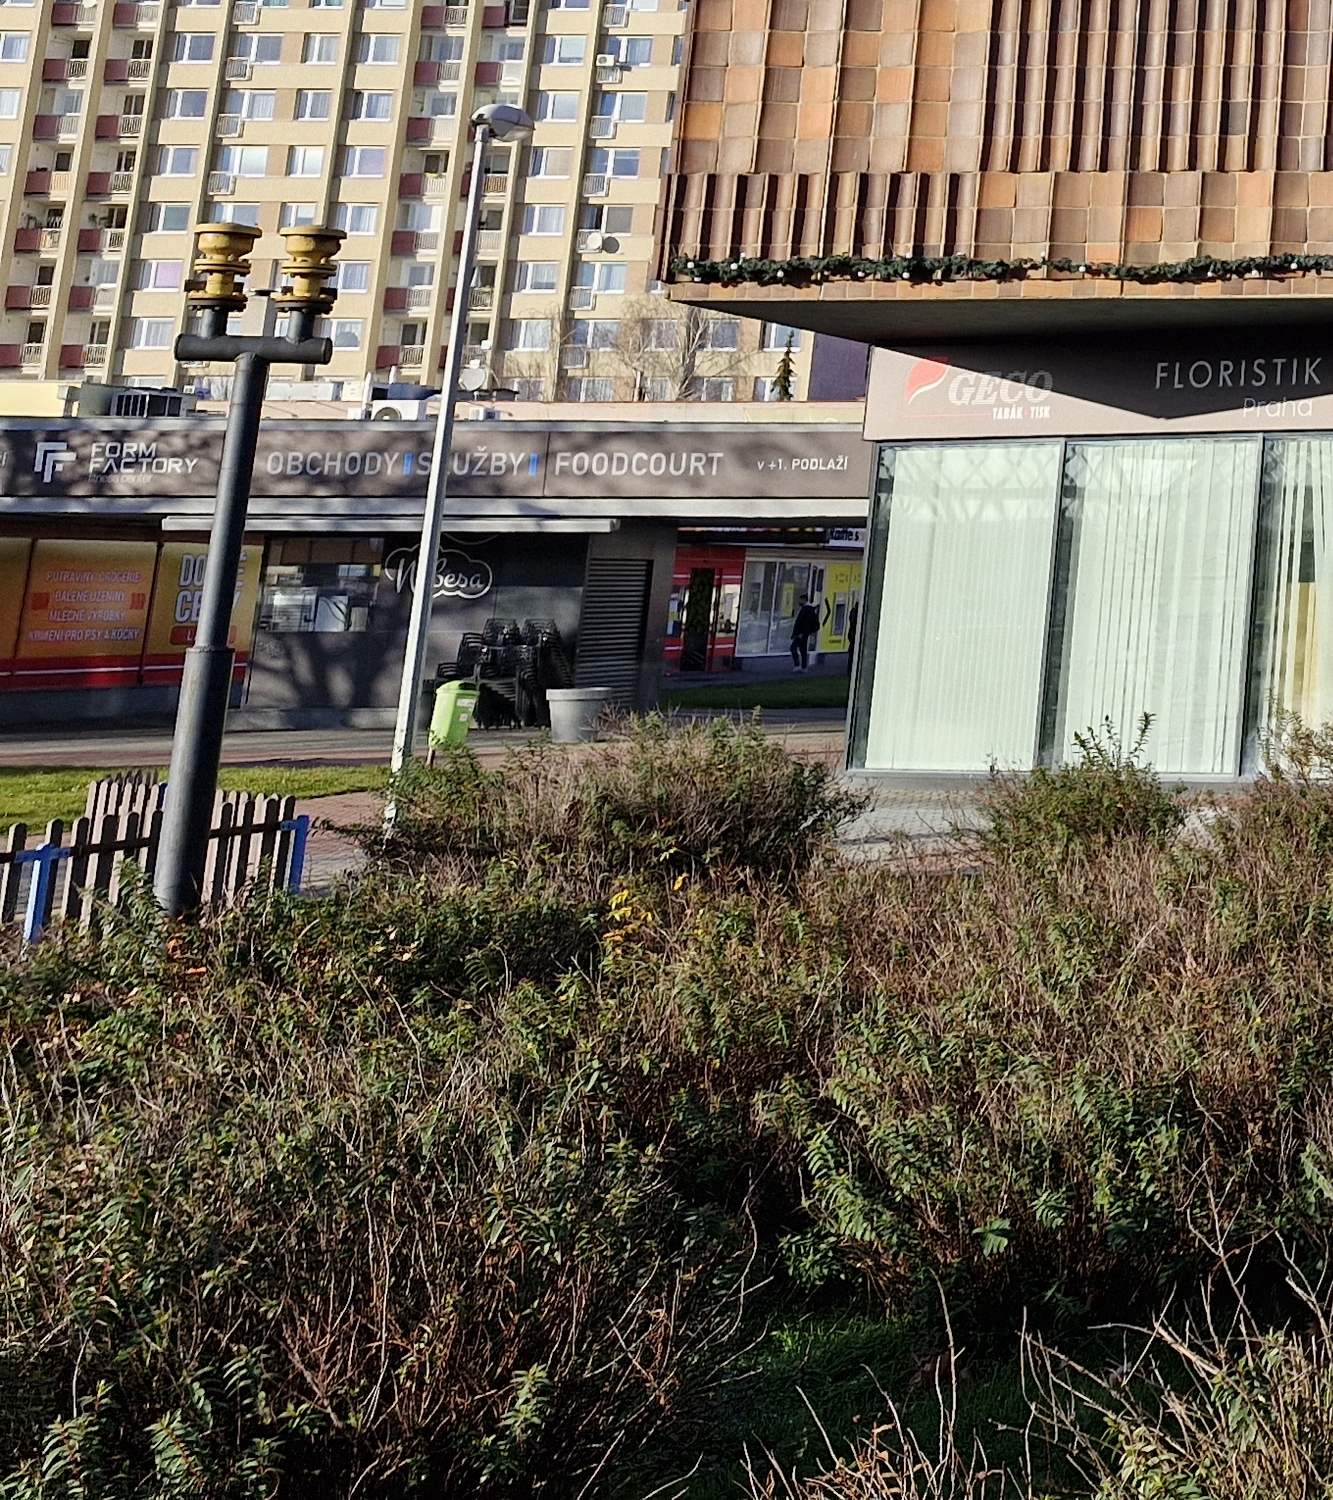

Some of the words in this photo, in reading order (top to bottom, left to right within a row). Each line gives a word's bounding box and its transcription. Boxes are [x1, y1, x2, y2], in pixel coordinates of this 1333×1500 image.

[1155, 357, 1323, 389] FLORISTIK
[949, 370, 1053, 405] GECO
[992, 404, 1023, 420] TABÁK
[1030, 406, 1051, 419] TISK
[1242, 397, 1313, 418] Praha
[91, 442, 157, 458] FORM
[89, 458, 199, 473] FACTORY
[266, 452, 400, 476] OBCHODY
[417, 446, 527, 476] SUŽBY
[554, 452, 724, 476] FOODCOURT
[791, 455, 848, 471] PODLAŽÍ
[121, 473, 153, 484] center
[396, 557, 485, 593] Nbesa
